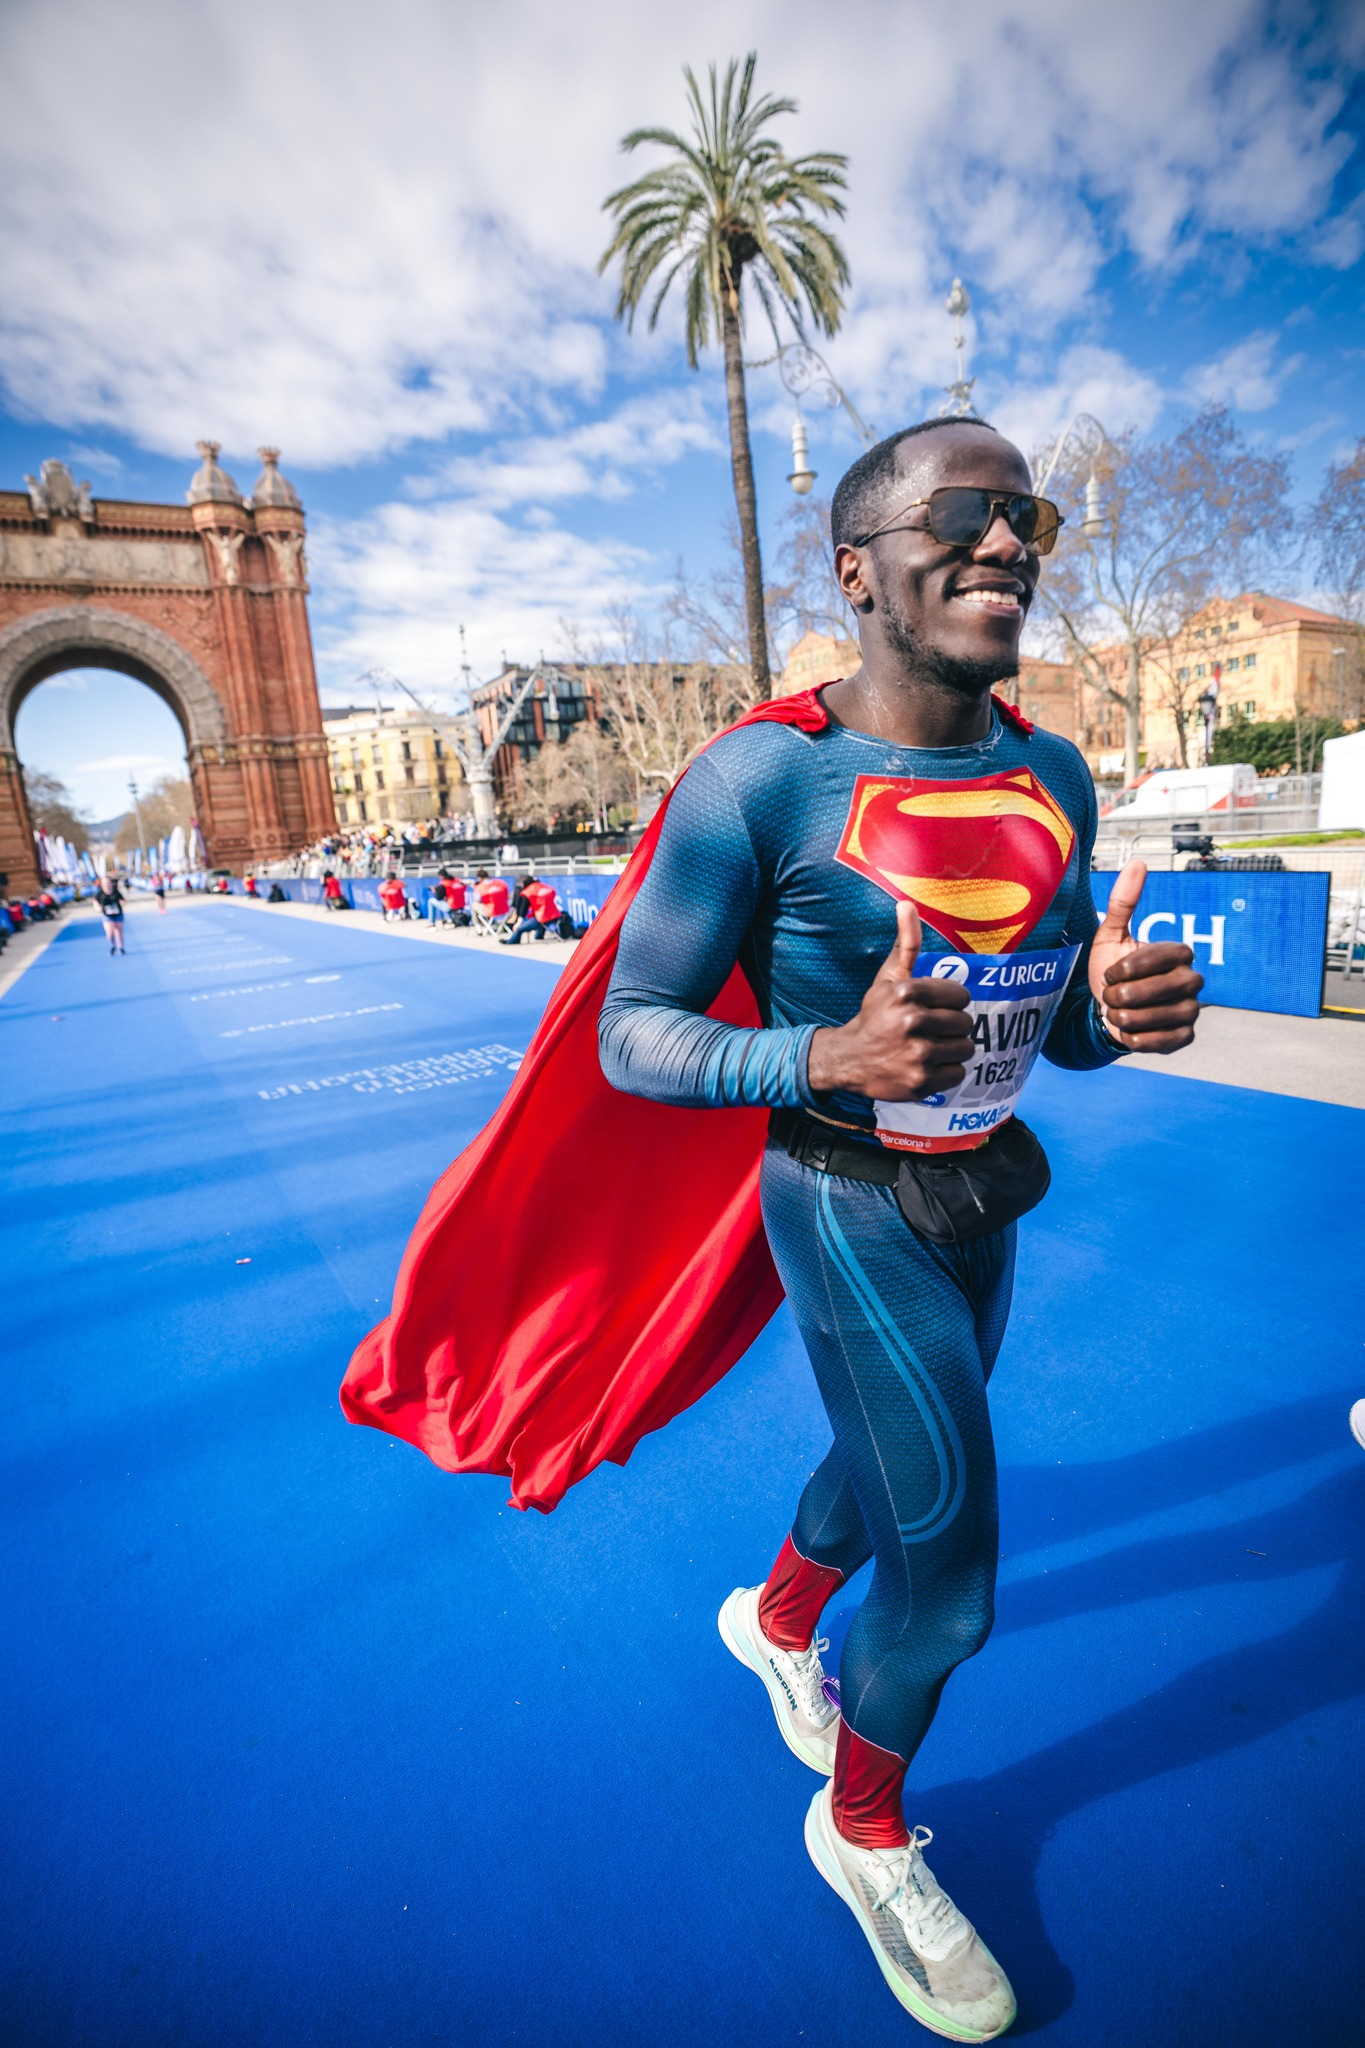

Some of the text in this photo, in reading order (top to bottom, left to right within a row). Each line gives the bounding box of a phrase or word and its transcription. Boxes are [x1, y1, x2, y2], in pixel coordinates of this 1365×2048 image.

[566, 888, 599, 928] imp
[977, 961, 1058, 988] ZURICH
[247, 1003, 404, 1033] Barcelona
[970, 1008, 1042, 1053] AVID
[394, 1068, 498, 1095] ZURICH
[973, 1057, 1018, 1087] 1622
[947, 1107, 999, 1132] HOKA
[880, 1133, 925, 1149] Barcelona
